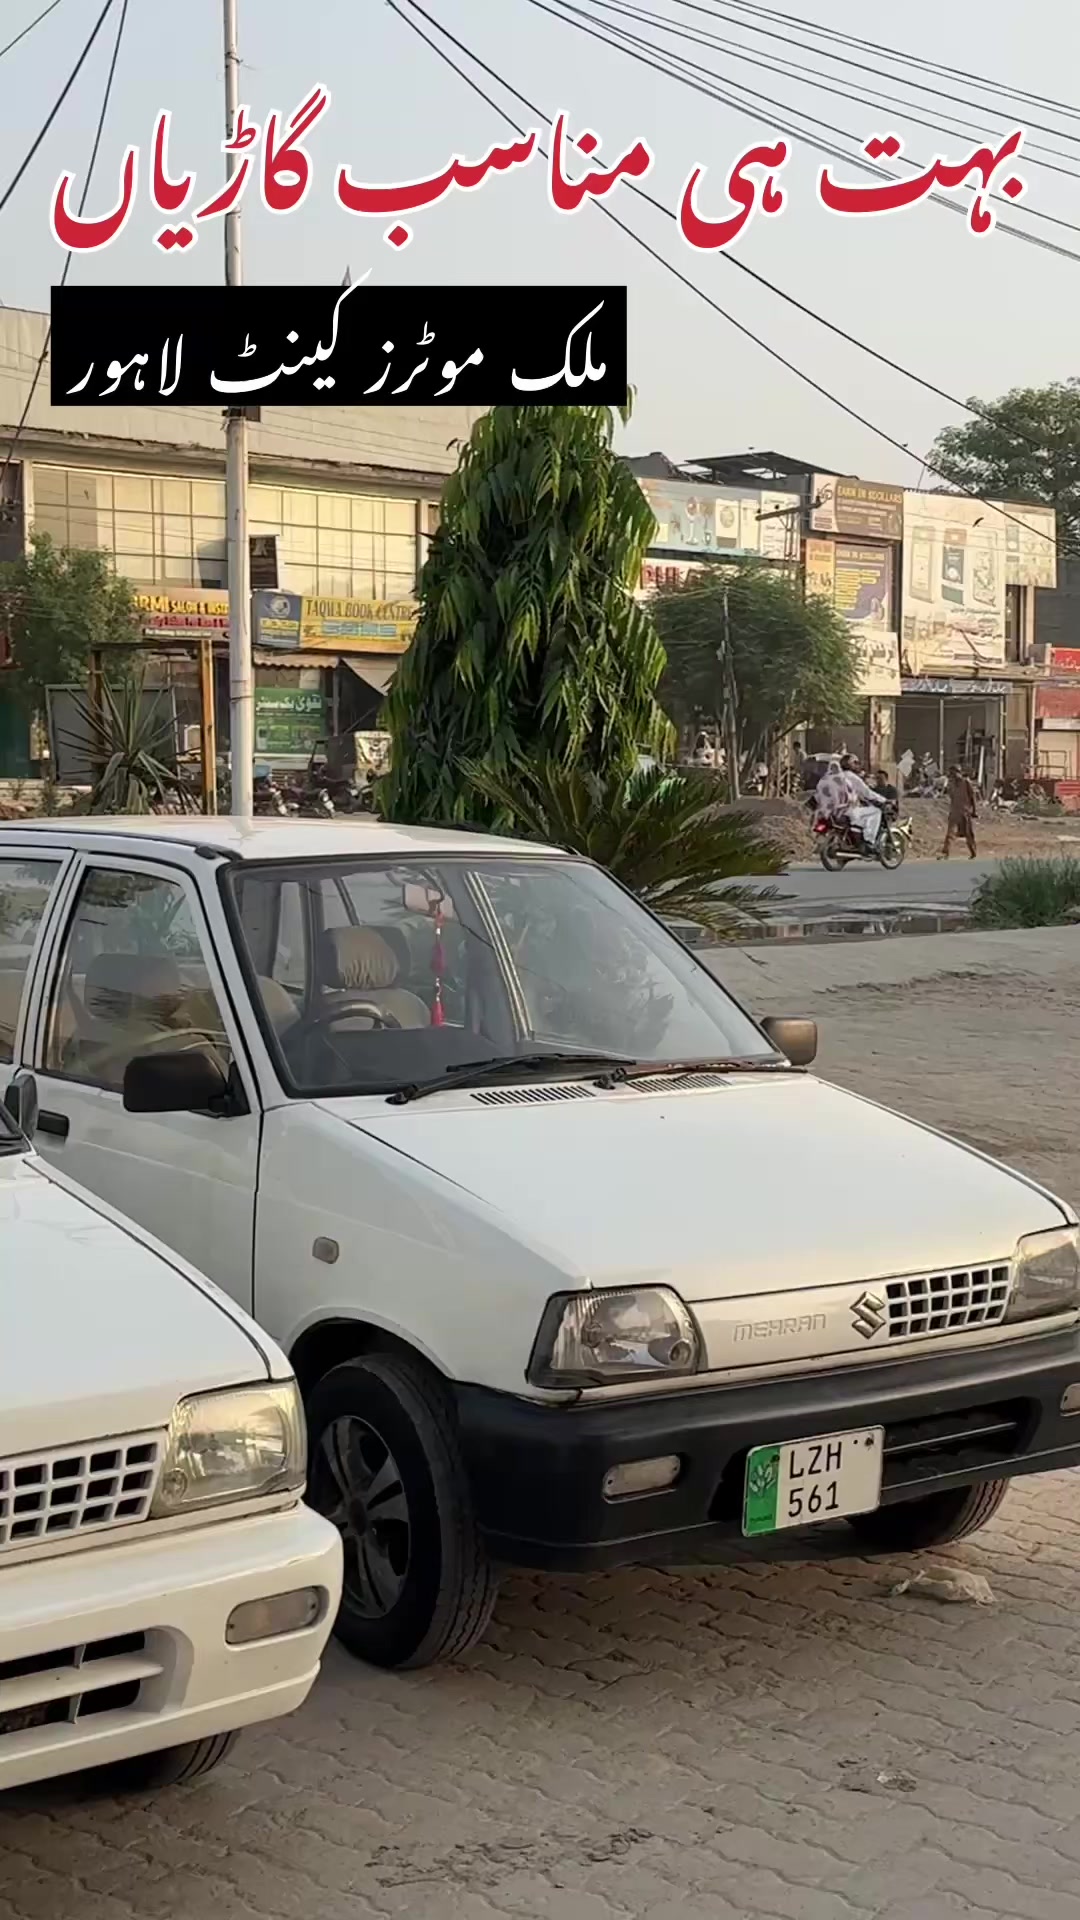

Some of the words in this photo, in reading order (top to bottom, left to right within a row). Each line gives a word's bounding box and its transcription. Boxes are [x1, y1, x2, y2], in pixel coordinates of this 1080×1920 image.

[305, 600, 345, 618] TAQWA
[345, 602, 373, 619] BOOK
[733, 1313, 826, 1341] MEHRAN
[789, 1441, 842, 1479] LZH
[788, 1481, 839, 1517] 561
